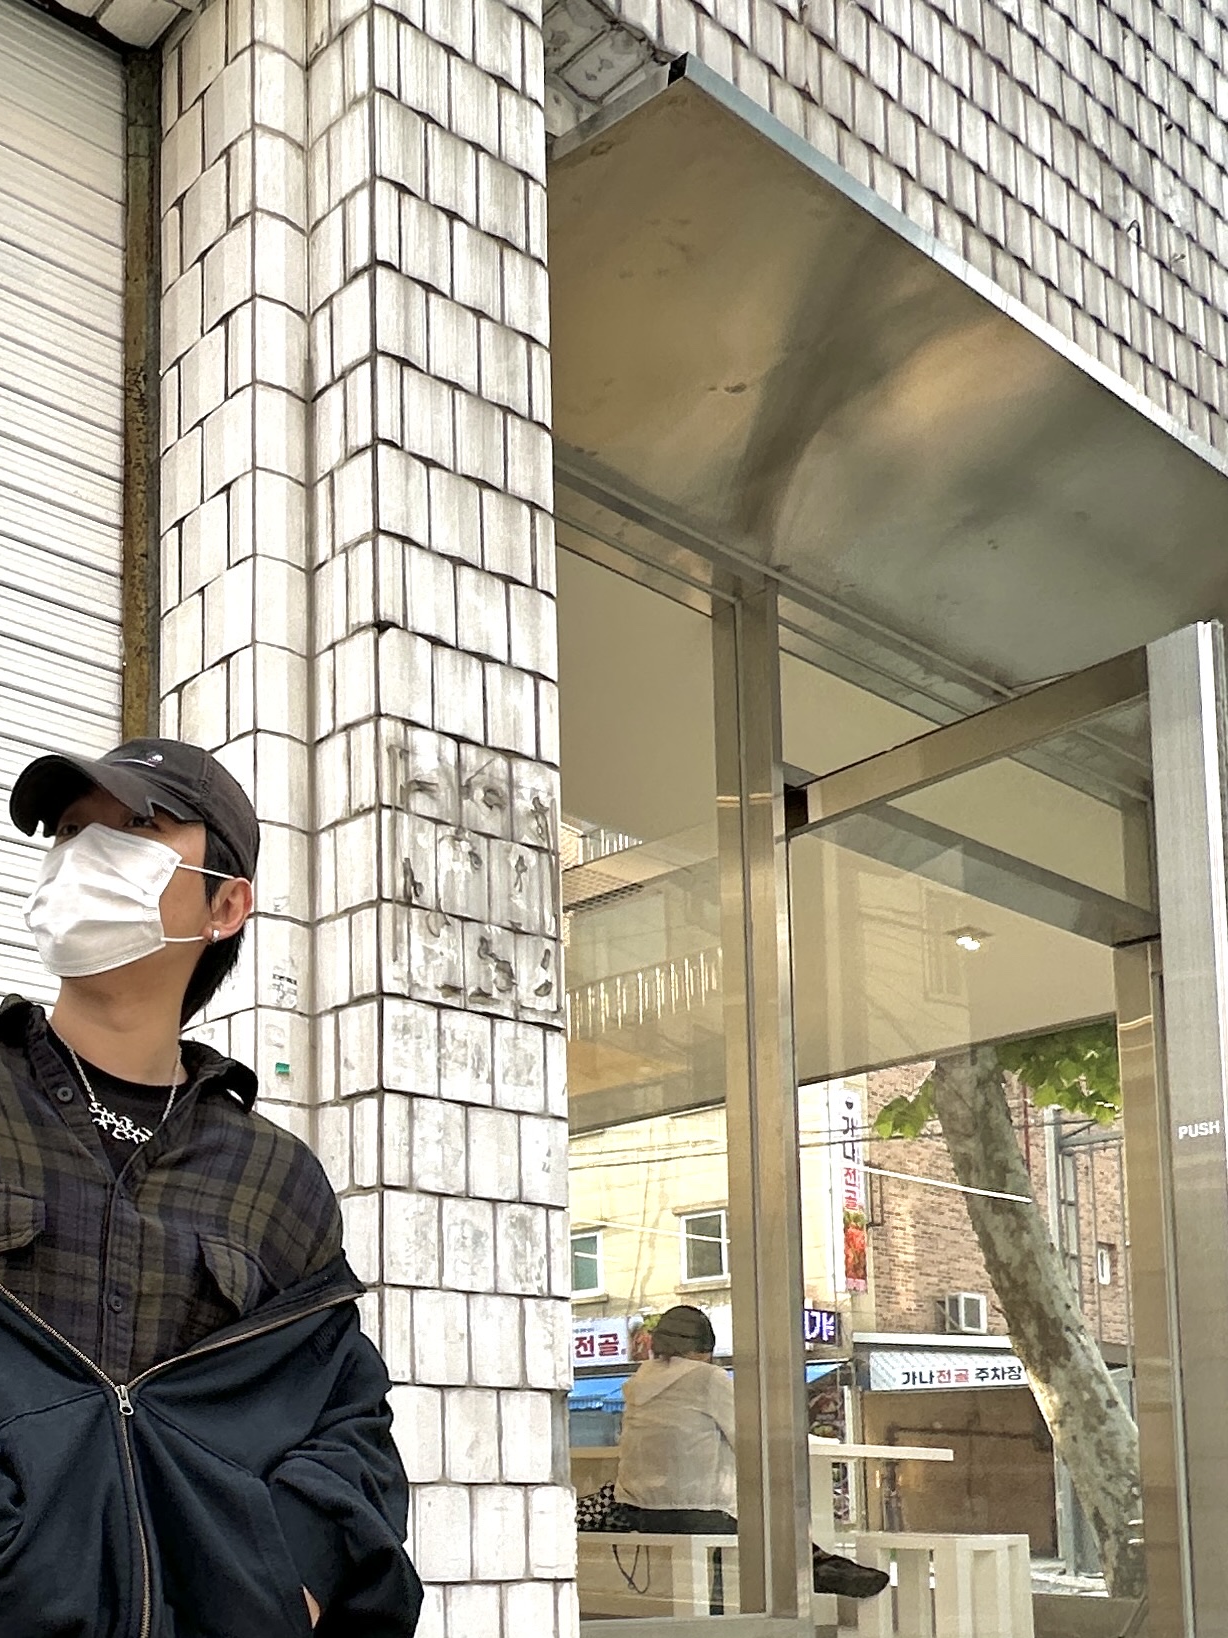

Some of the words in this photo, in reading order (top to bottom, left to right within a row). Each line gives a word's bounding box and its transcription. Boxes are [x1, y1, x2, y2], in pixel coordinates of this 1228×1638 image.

[1178, 1120, 1220, 1140] PUSH
[575, 1333, 620, 1358] 전골
[901, 1369, 970, 1386] 가나전골
[975, 1365, 1023, 1382] 주차장
